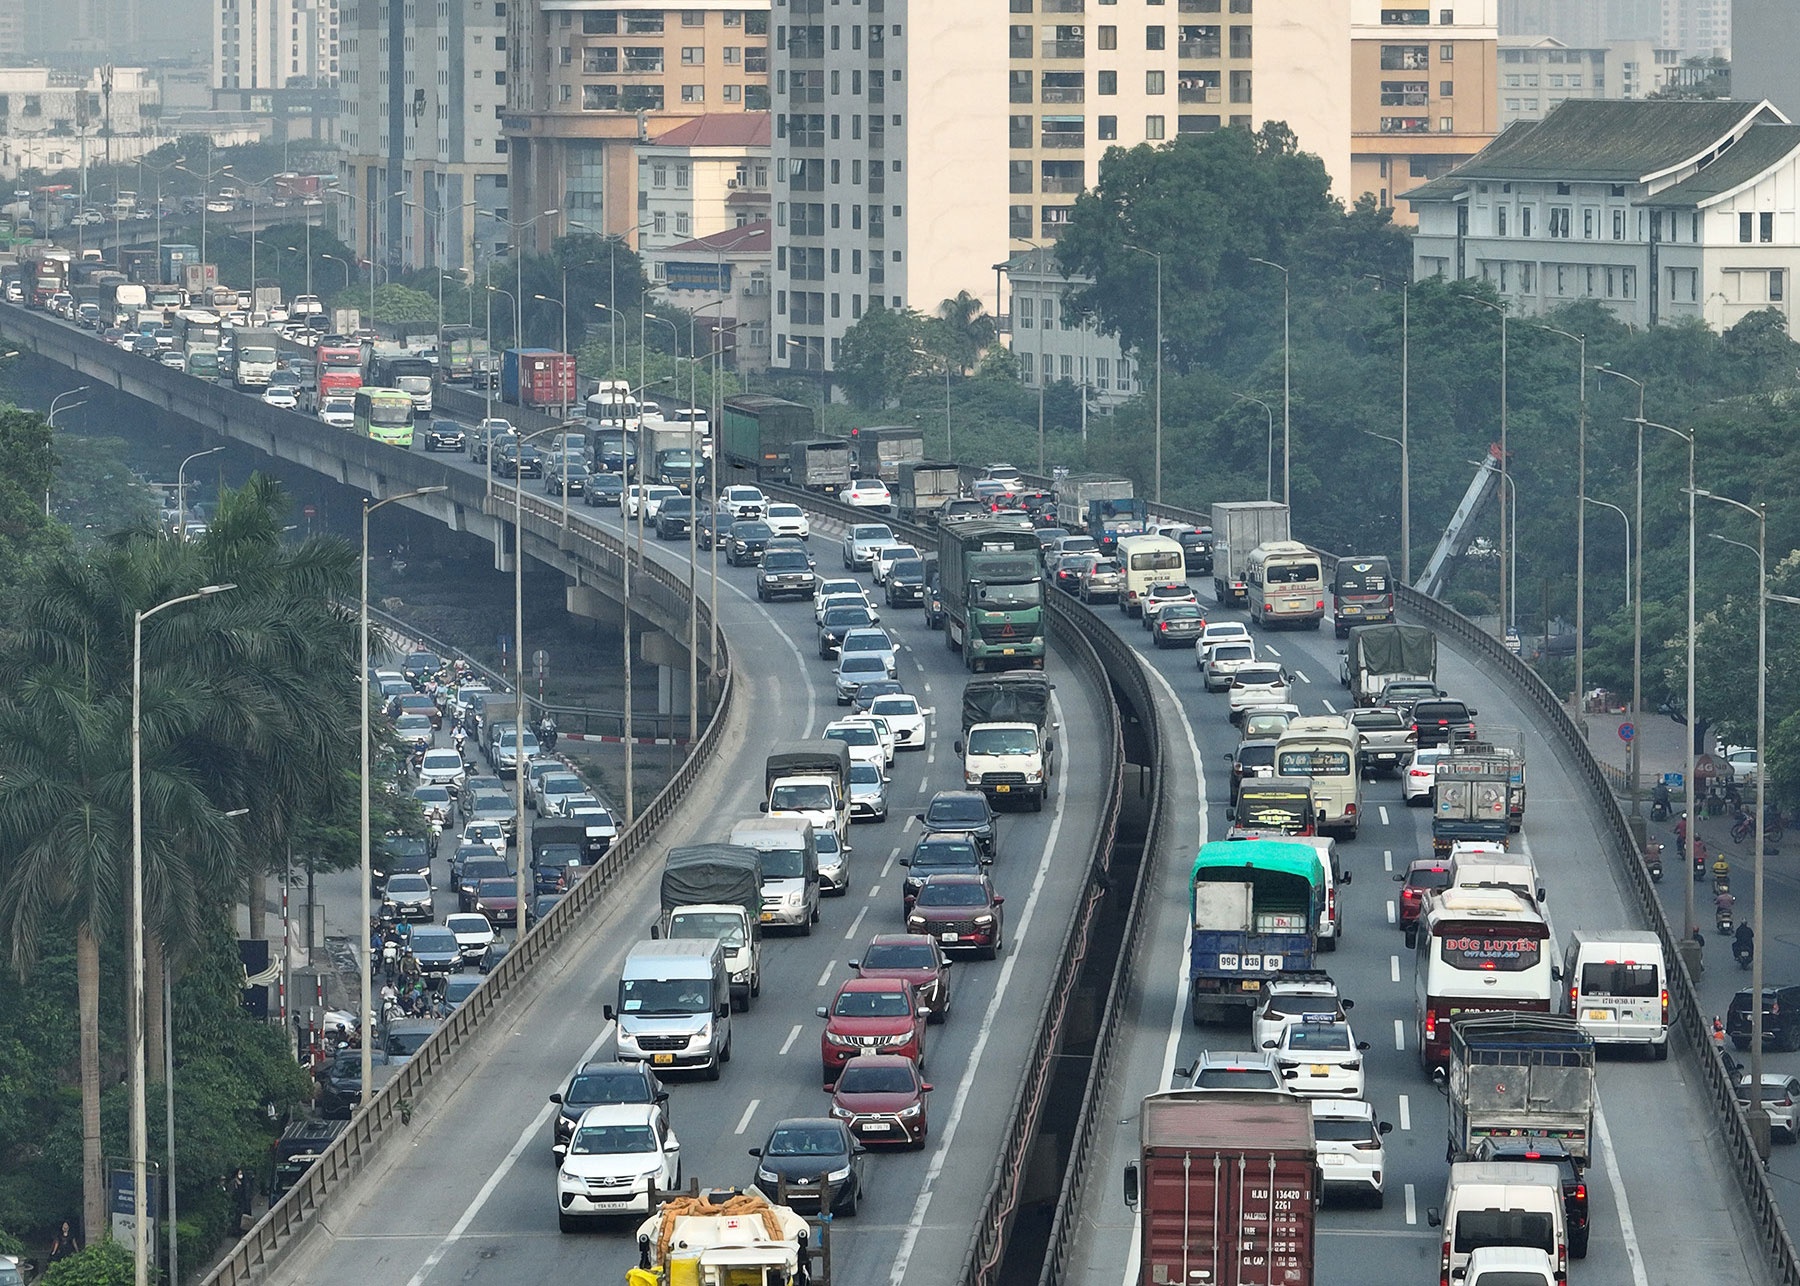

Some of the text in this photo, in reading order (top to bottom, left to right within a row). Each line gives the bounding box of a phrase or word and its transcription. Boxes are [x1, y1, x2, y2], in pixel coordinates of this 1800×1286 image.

[1221, 957, 1279, 967] 99C 036 98
[1276, 1190, 1300, 1199] 136420
